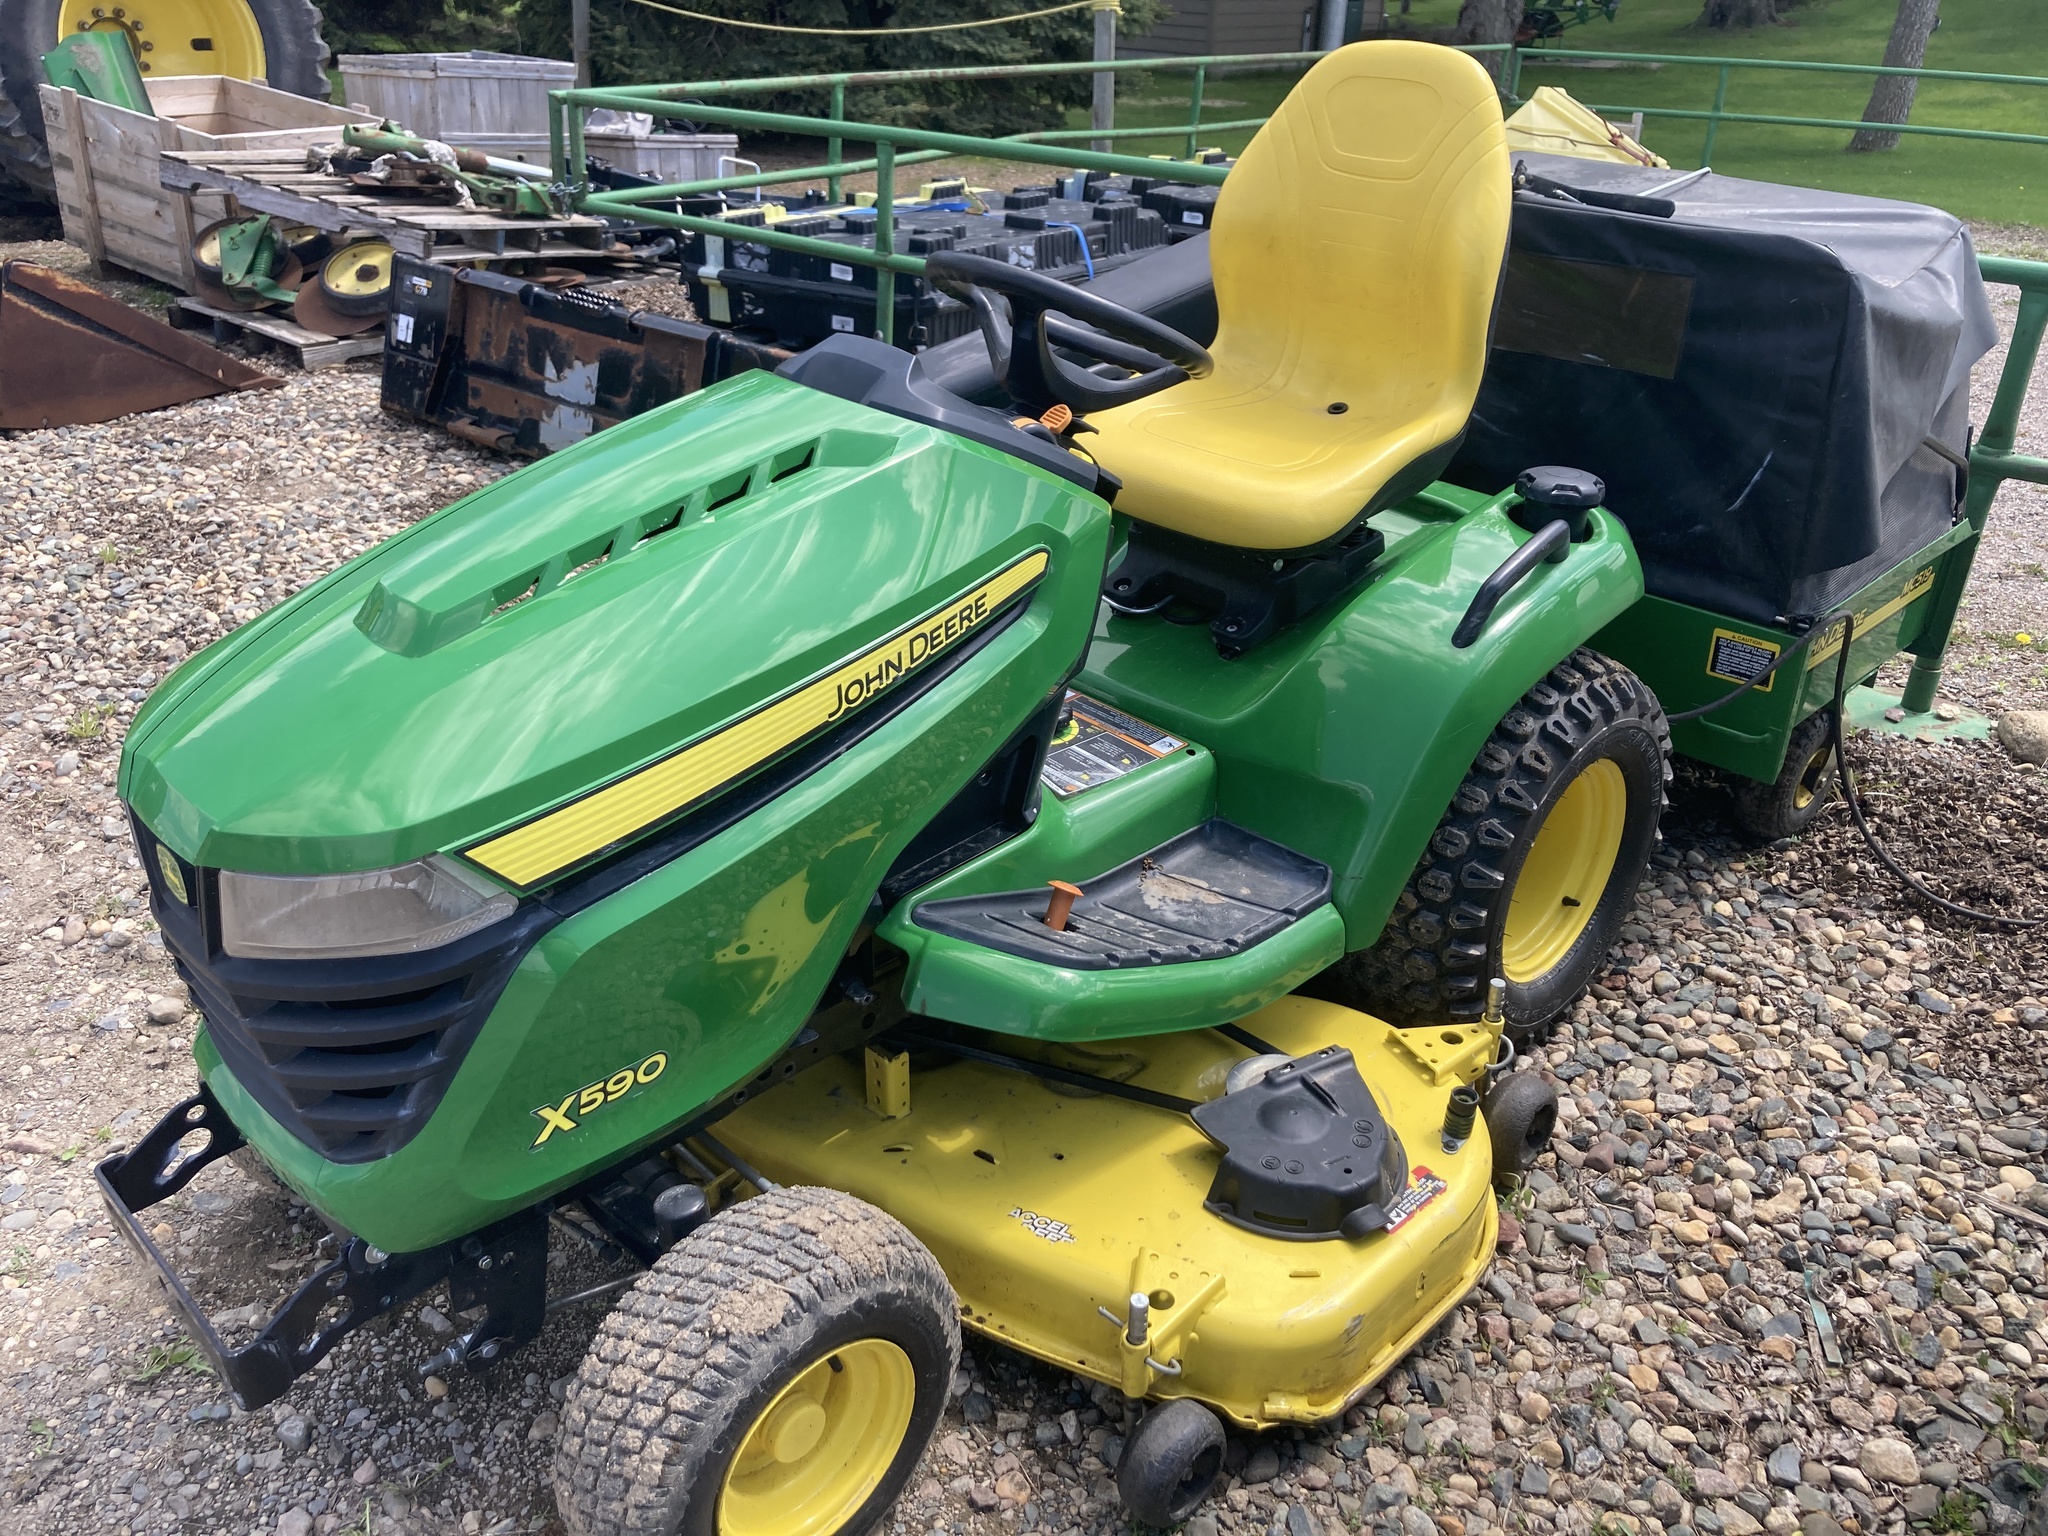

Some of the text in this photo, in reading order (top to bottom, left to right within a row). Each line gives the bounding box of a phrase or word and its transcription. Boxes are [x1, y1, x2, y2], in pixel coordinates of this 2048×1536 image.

[1737, 635, 1763, 647] CAUTION
[1828, 607, 1868, 648] DERE
[827, 591, 991, 721] JOHN DEERE
[528, 1051, 669, 1150] X590
[1007, 1206, 1073, 1238] ACCEL
